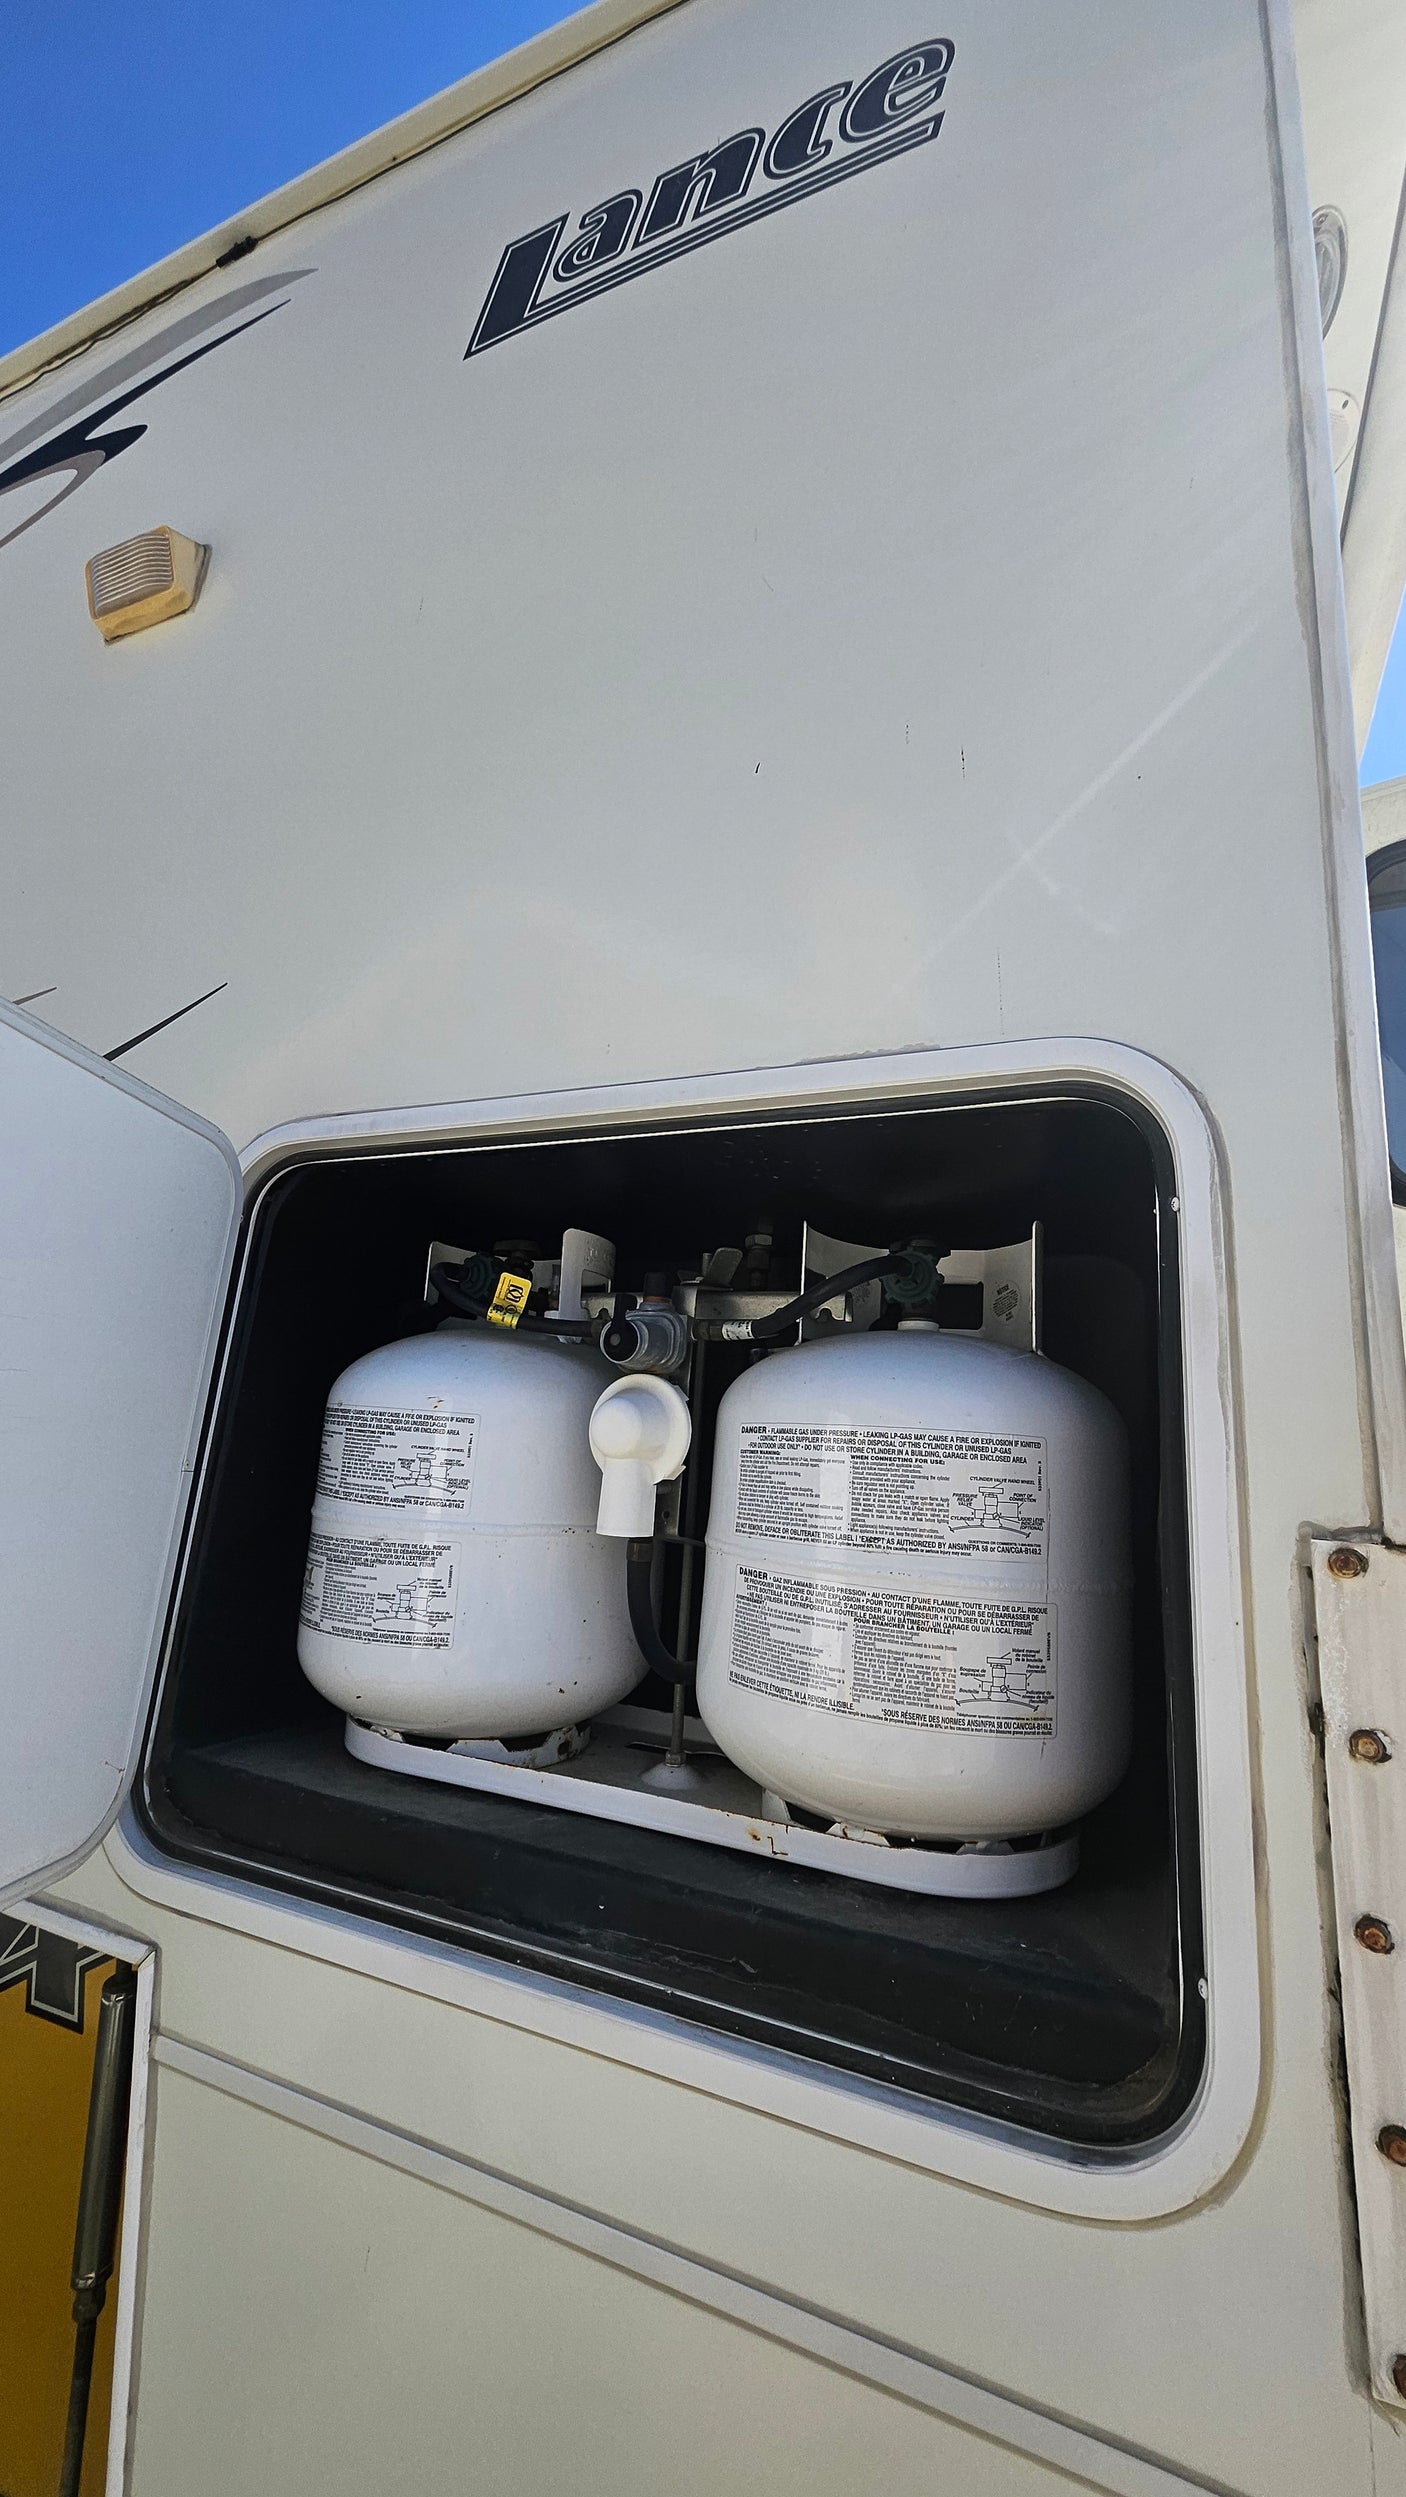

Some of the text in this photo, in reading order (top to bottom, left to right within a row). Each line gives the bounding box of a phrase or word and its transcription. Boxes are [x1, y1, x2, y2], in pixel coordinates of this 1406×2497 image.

[463, 38, 955, 361] Lance
[928, 1434, 948, 1442] CAUSE
[956, 1436, 970, 1444] FIRE
[981, 1438, 1013, 1447] EXPLOSION
[942, 1451, 968, 1460] GARAGE
[980, 1454, 1010, 1463] ENCLOSED
[765, 1525, 780, 1533] DEFACE
[790, 1528, 821, 1538] OBLITERATE
[836, 1533, 854, 1542] LABEL
[896, 1539, 936, 1548] AUTHORIZED
[740, 1567, 768, 1580] DANGER
[783, 1578, 818, 1590] INFLAMMABLE
[820, 1583, 835, 1592] SOUS
[837, 1586, 866, 1596] PRESSION
[881, 1593, 911, 1603] CONTACT
[912, 1596, 931, 1605] D'UNE
[933, 1598, 961, 1608] FLAMME,
[962, 1602, 982, 1610] TOUTE
[984, 1604, 1000, 1612] FUITE
[806, 1588, 814, 1596] OU
[815, 1589, 826, 1598] UNE
[828, 1591, 860, 1603] EXPLOSION
[866, 1597, 883, 1605] POUR
[884, 1600, 904, 1609] TOUTE
[906, 1601, 946, 1614] RÉPARATION
[987, 1610, 1030, 1621] DÉBARRASSER
[844, 1602, 882, 1613] S'ADRESSER
[883, 1607, 892, 1615] AU
[894, 1609, 939, 1620] FOURNISSEUR
[944, 1614, 978, 1624] N'UTILISER
[790, 1600, 825, 1612] ENTREPOSER
[834, 1608, 868, 1618] BOUTEILLE
[943, 1622, 969, 1631] GARAGE
[1013, 1627, 1032, 1635] FERMÉ
[808, 1694, 828, 1705] RENDRE
[901, 1710, 927, 1722] RÉSERVE
[929, 1715, 940, 1723] DES
[941, 1717, 965, 1727] NORMES
